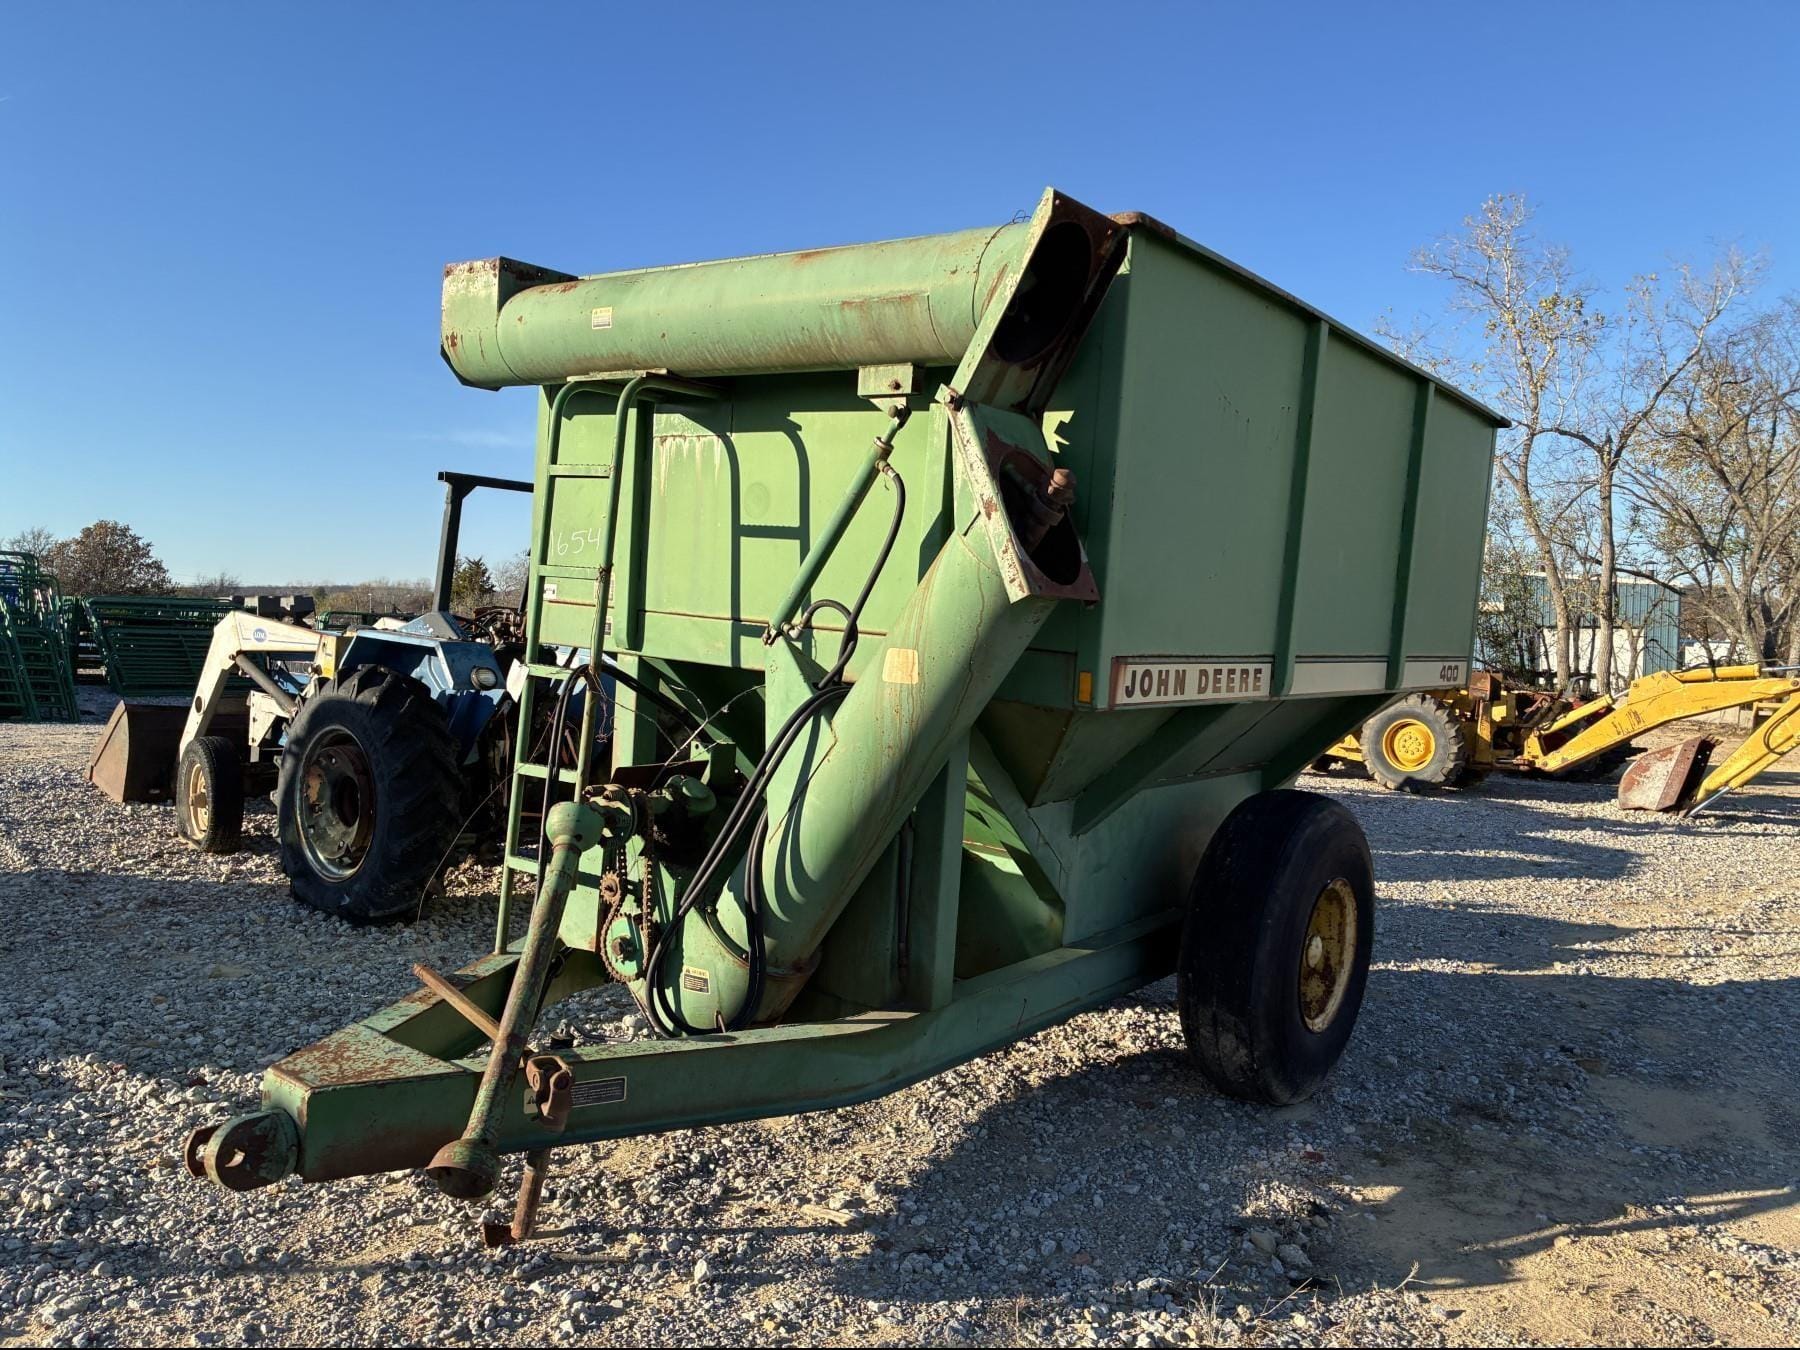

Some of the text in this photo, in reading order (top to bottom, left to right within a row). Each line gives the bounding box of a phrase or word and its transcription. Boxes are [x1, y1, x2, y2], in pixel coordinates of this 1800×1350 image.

[550, 528, 601, 556] 1654
[1125, 668, 1262, 698] JOHN DEERE
[1440, 665, 1459, 682] 400
